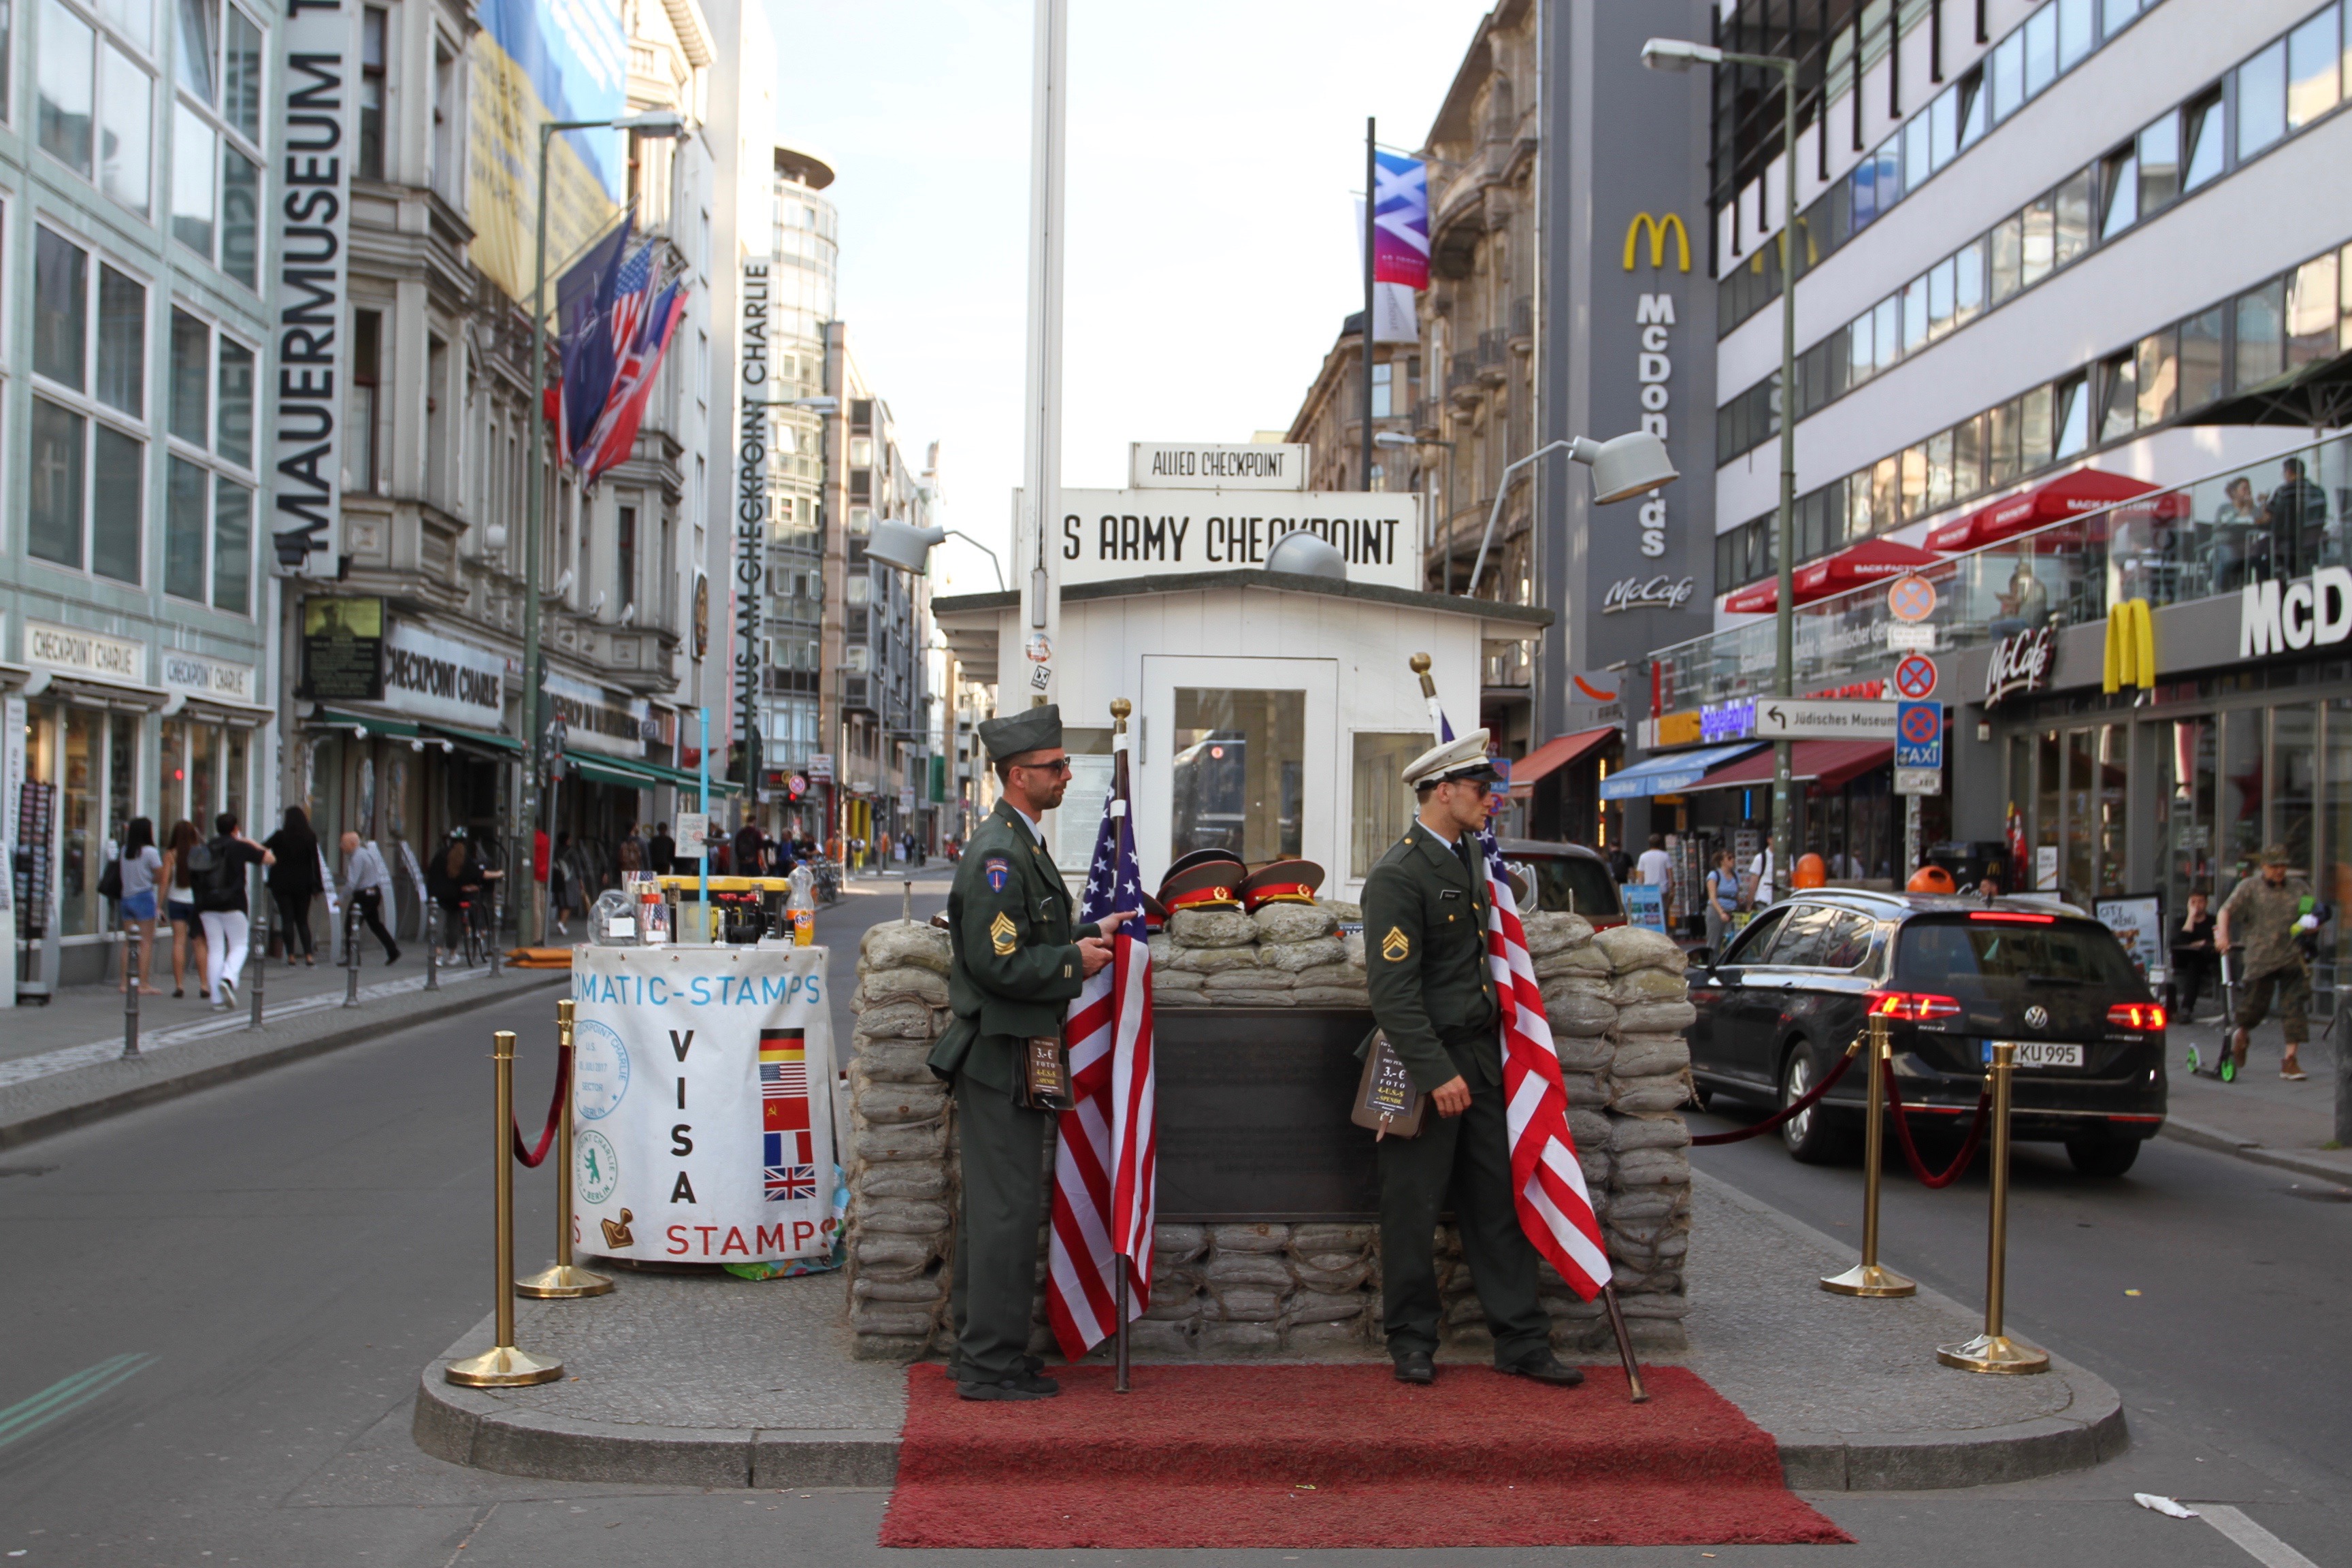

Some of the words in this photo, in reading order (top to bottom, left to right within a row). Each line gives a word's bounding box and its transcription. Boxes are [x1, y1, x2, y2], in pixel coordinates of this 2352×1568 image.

[276, 54, 342, 551] MAUERMUSEUM
[742, 264, 768, 385] CHARLIE
[1152, 451, 1195, 476] ALLIED
[1201, 452, 1285, 477] CHECKPOINT
[738, 396, 765, 583] CHECKPOINT
[1063, 514, 1081, 560] S
[1099, 514, 1190, 562] ARMY
[736, 595, 761, 642] AM
[2239, 566, 2352, 659] McD
[33, 631, 92, 664] CHECKPOINT
[95, 644, 133, 676] CHARLIE
[167, 658, 212, 689] CHECKPOINT
[214, 667, 244, 696] CHARLIE
[458, 666, 500, 709] CHARLIE
[734, 653, 760, 729] HAUS
[1794, 711, 1847, 725] Jüdisches
[1851, 713, 1897, 726] Museum
[1901, 748, 1938, 764] TAXI
[585, 1042, 597, 1051] U.S.
[610, 1037, 627, 1082] CHARLIE
[1036, 1060, 1056, 1069] FOTO
[2019, 1044, 2042, 1062] KU
[2045, 1045, 2076, 1063] 995
[582, 1081, 604, 1092] SECTOR
[1379, 1078, 1406, 1089] FOTO
[1399, 1069, 1407, 1080] €
[582, 1105, 606, 1117] BERLIN
[668, 1029, 698, 1204] VISA
[1379, 1095, 1403, 1105] SPENDE
[593, 1134, 616, 1172] CHARLIE
[587, 1184, 610, 1200] BERLIN
